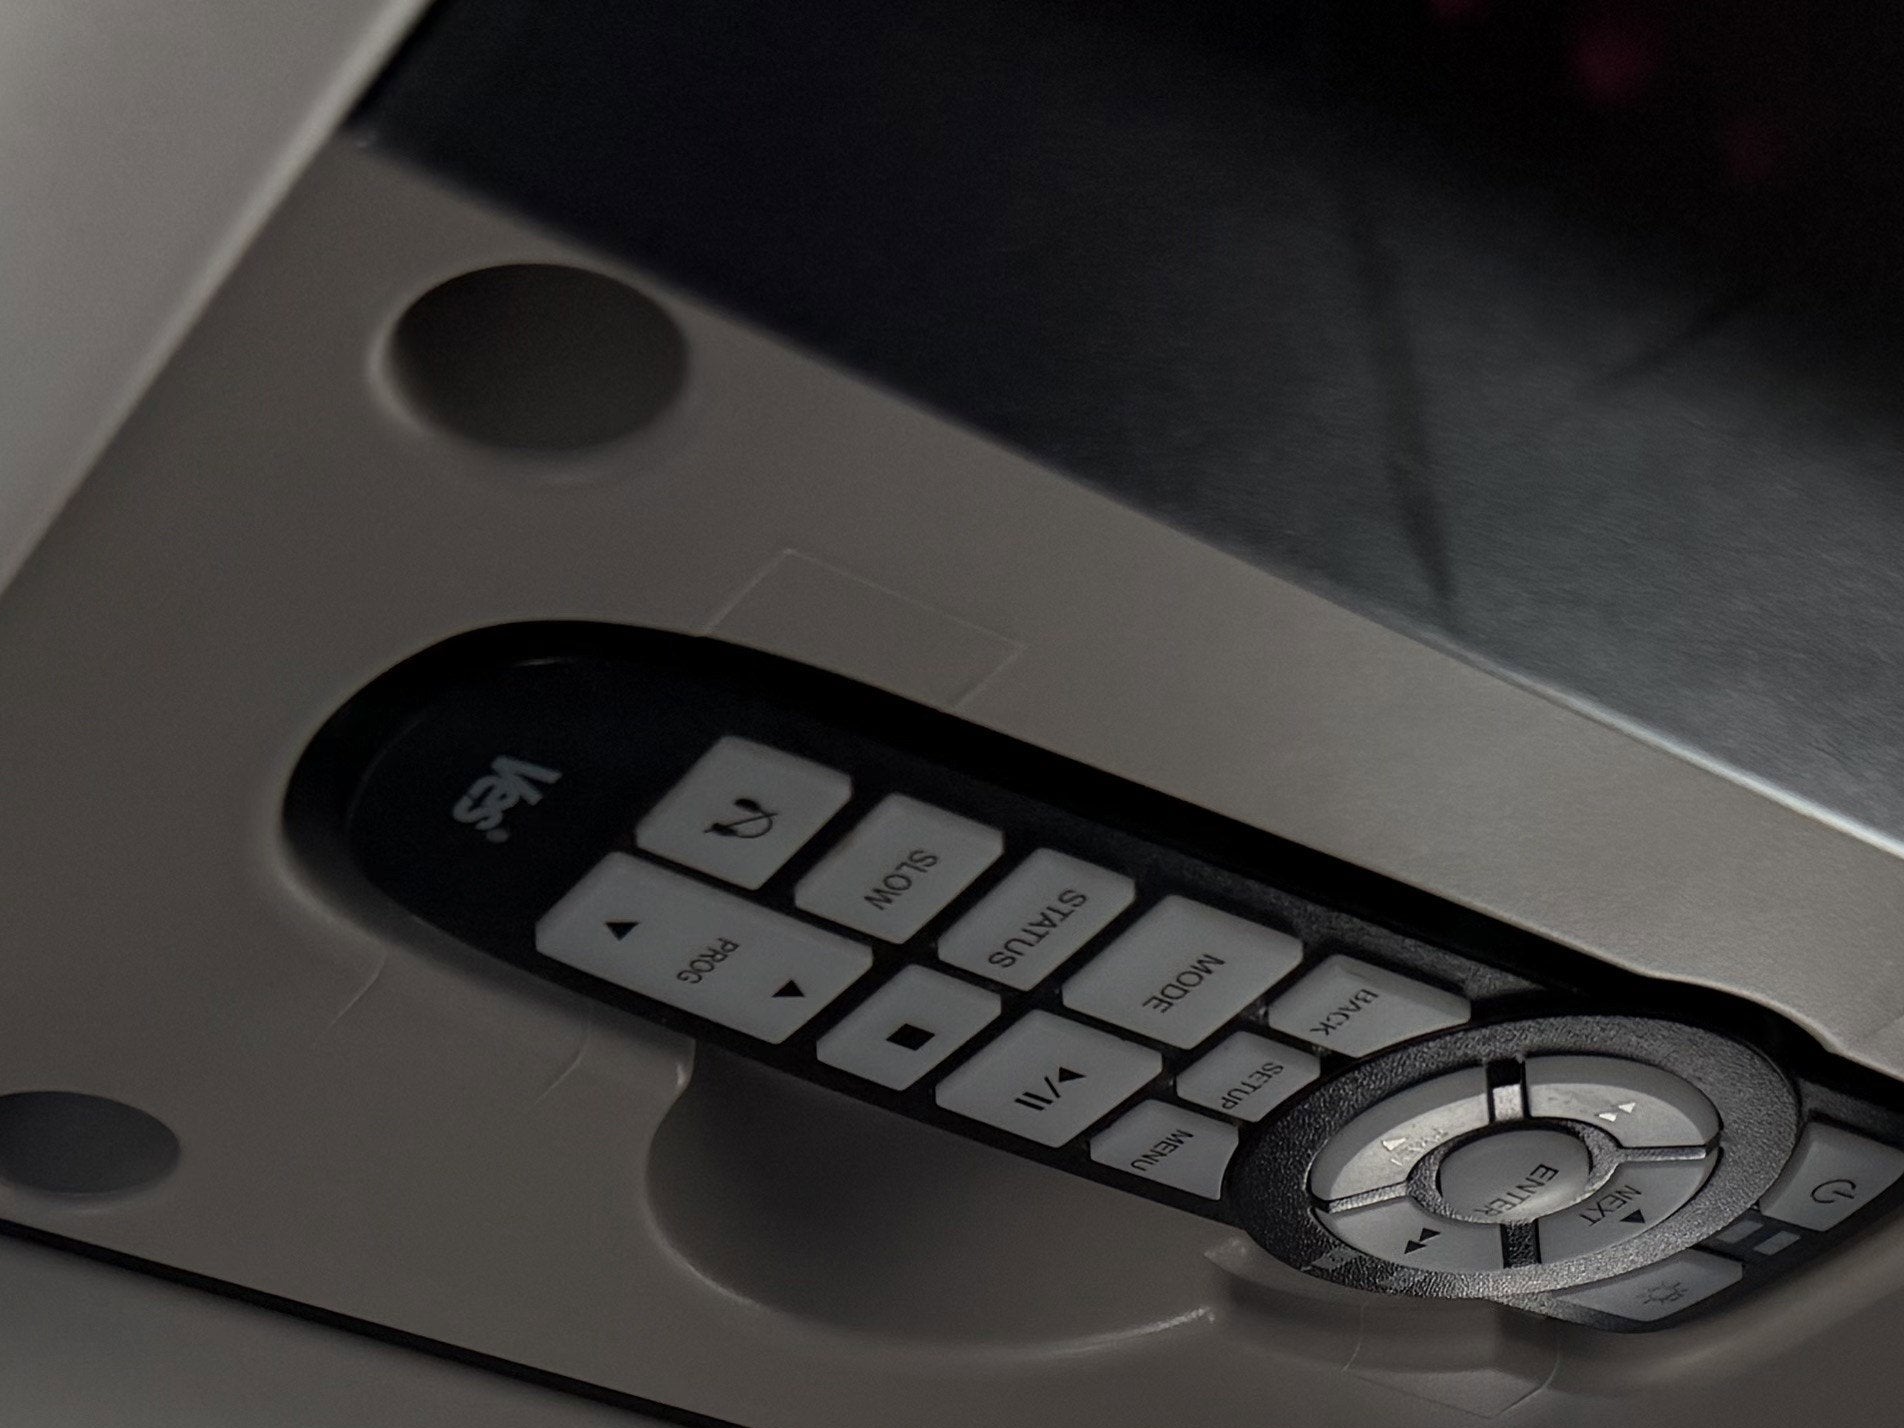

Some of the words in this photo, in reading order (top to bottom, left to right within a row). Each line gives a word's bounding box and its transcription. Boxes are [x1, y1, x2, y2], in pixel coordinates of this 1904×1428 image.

[863, 850, 939, 911] SLOW
[987, 888, 1088, 969] STATUS
[676, 936, 740, 984] PROG
[1142, 953, 1226, 1014] MODE
[1309, 988, 1380, 1037] BACK
[1221, 1061, 1285, 1111] SETUP
[1129, 1128, 1195, 1172] MENU
[1473, 1163, 1560, 1217] ENTER
[1579, 1184, 1643, 1227] NEXT
